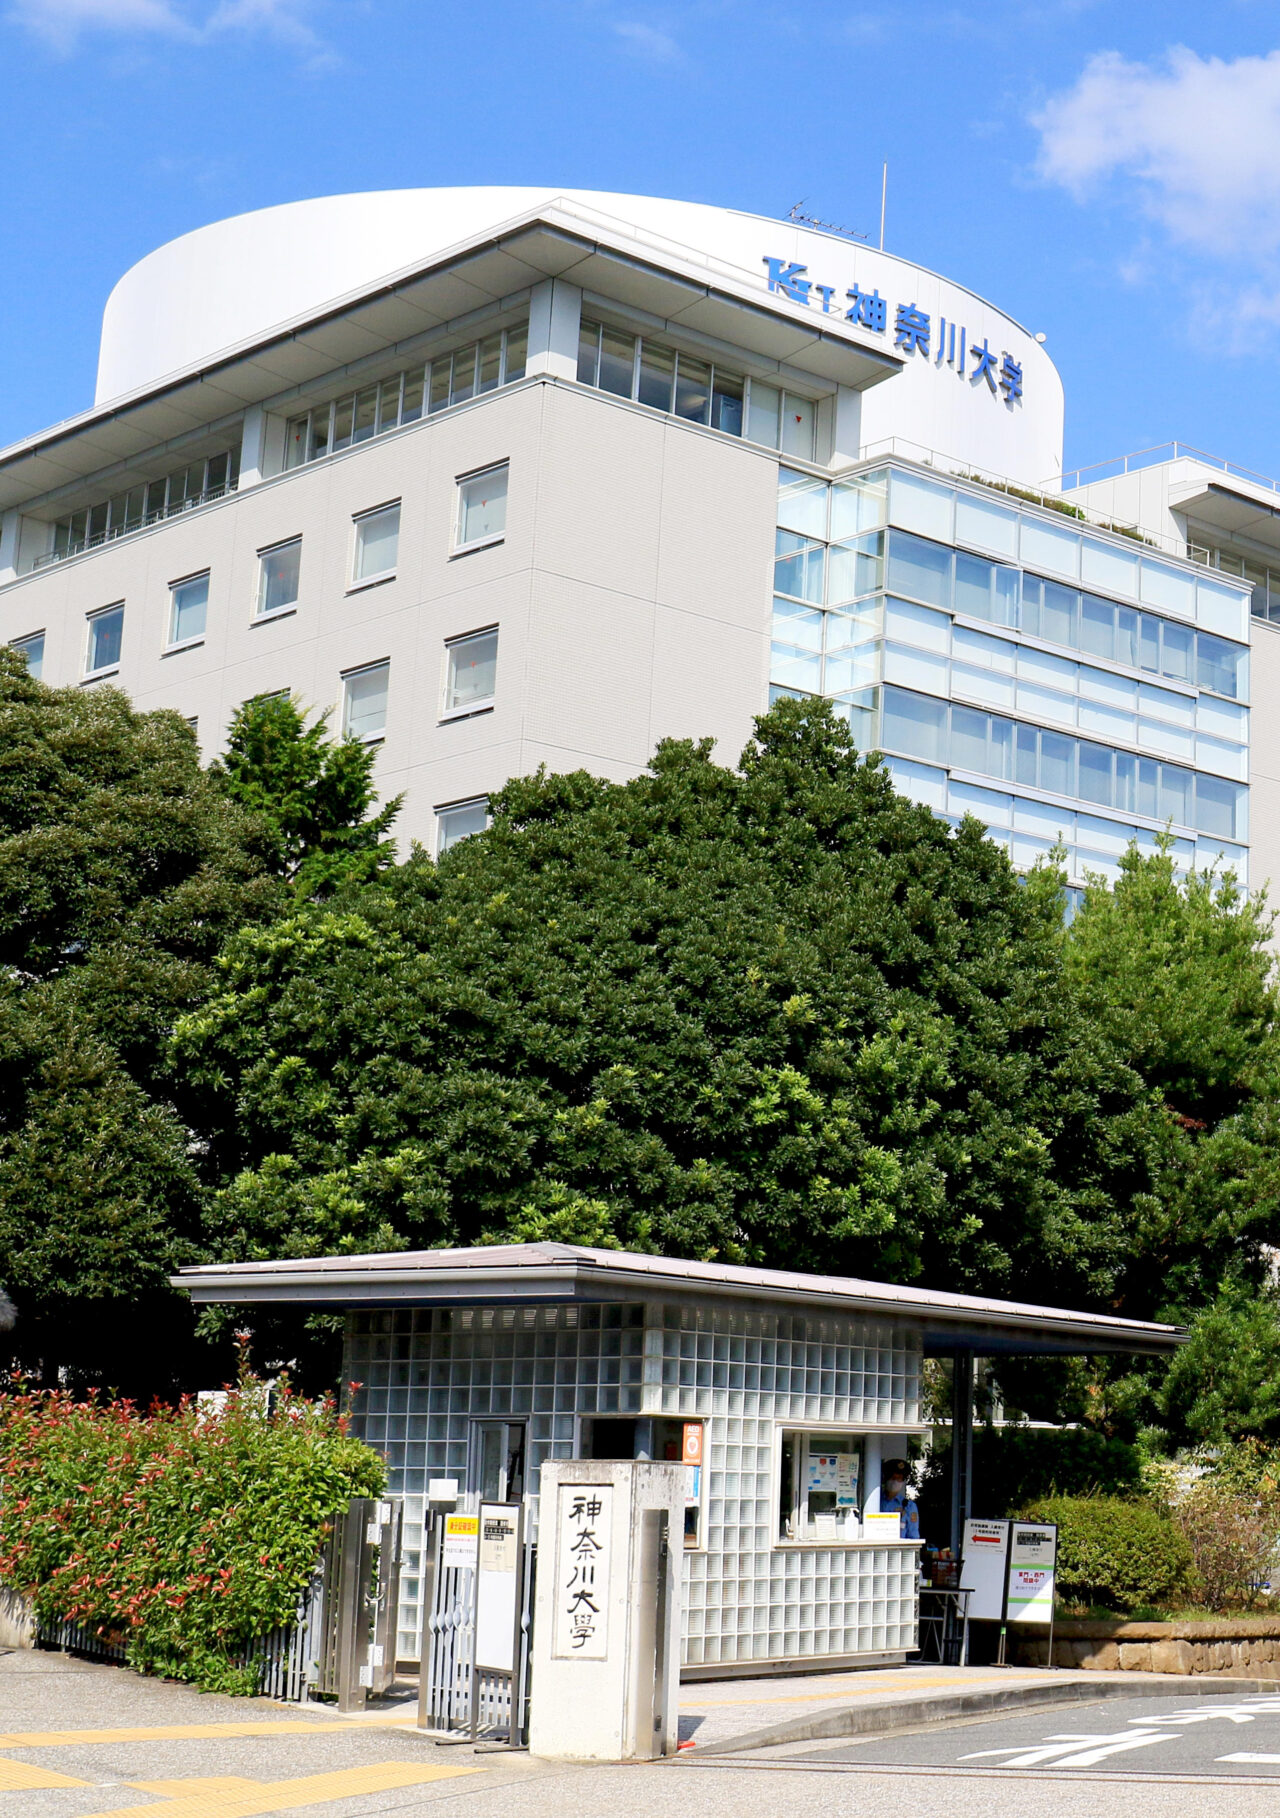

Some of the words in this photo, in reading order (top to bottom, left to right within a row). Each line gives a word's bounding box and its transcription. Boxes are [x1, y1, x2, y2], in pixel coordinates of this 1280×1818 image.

[844, 282, 1023, 402] 神奈川大学
